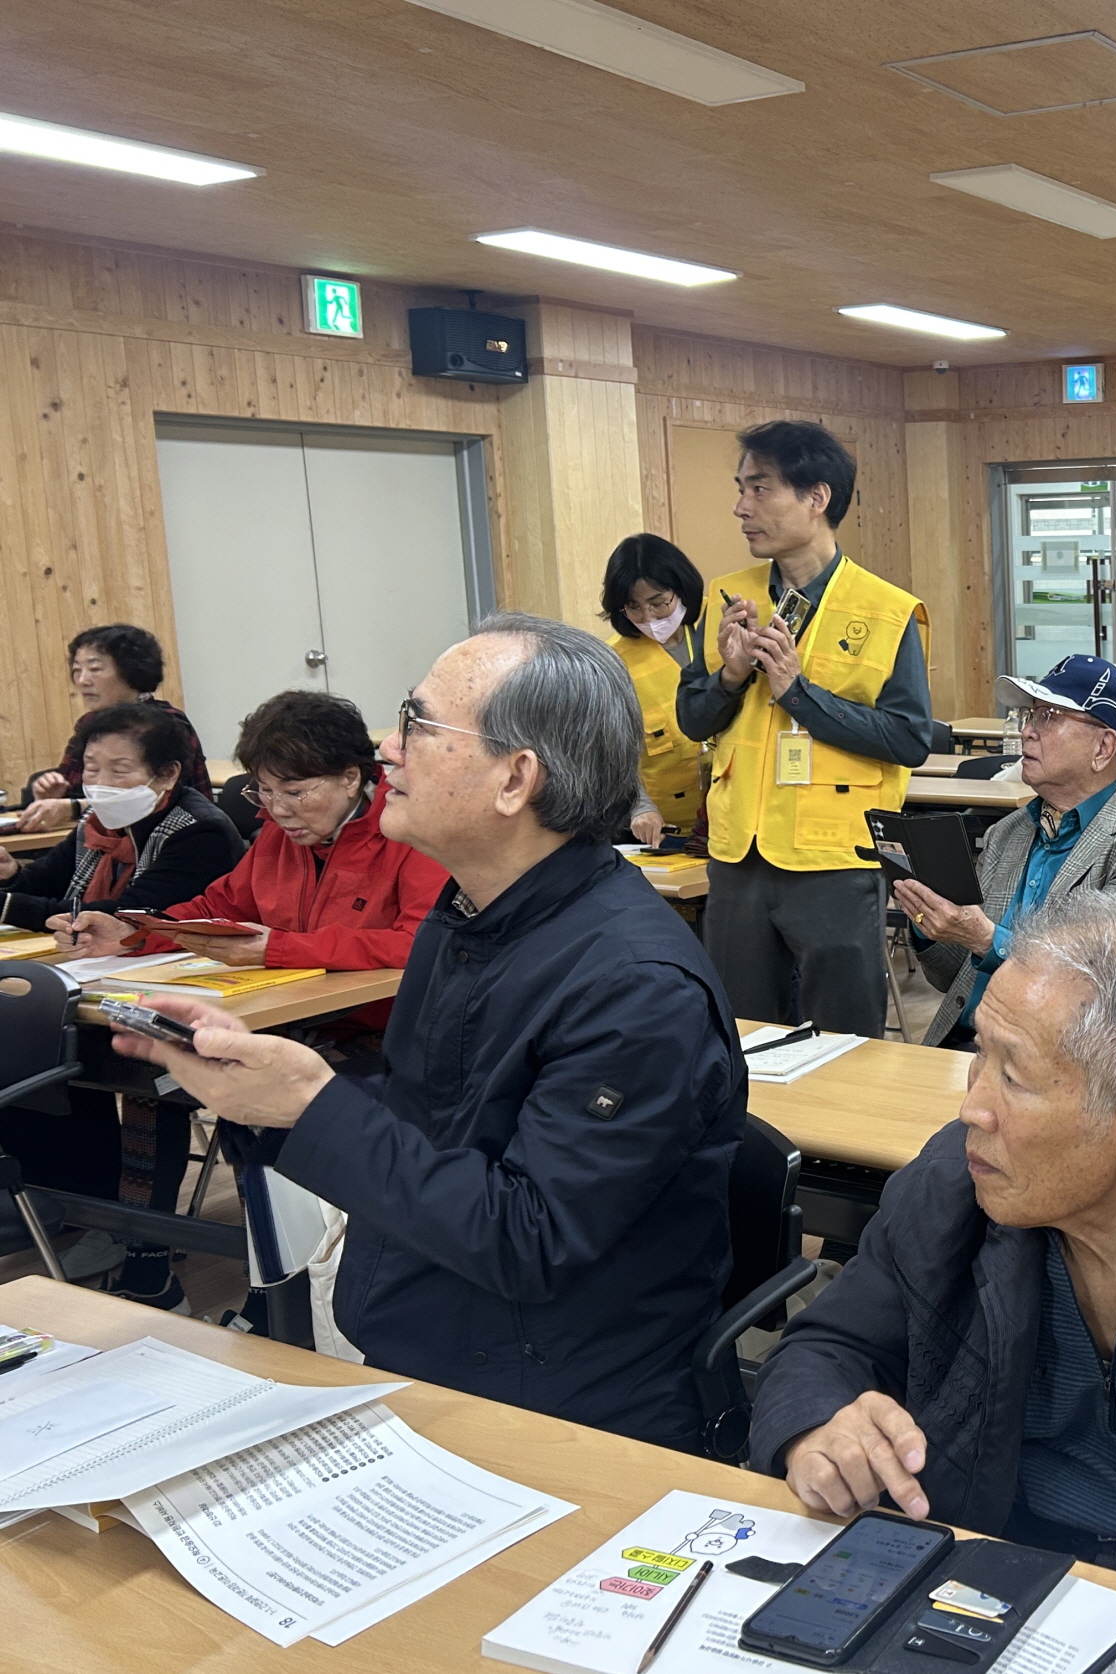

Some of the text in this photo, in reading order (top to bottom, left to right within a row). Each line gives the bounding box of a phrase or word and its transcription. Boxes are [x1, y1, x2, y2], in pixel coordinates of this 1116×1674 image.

[141, 1250, 168, 1258] FACE
[628, 1549, 688, 1568] 디지털 스쿨
[635, 1568, 673, 1581] 시니어
[609, 1579, 656, 1596] 찾아가는
[279, 1617, 296, 1628] 18
